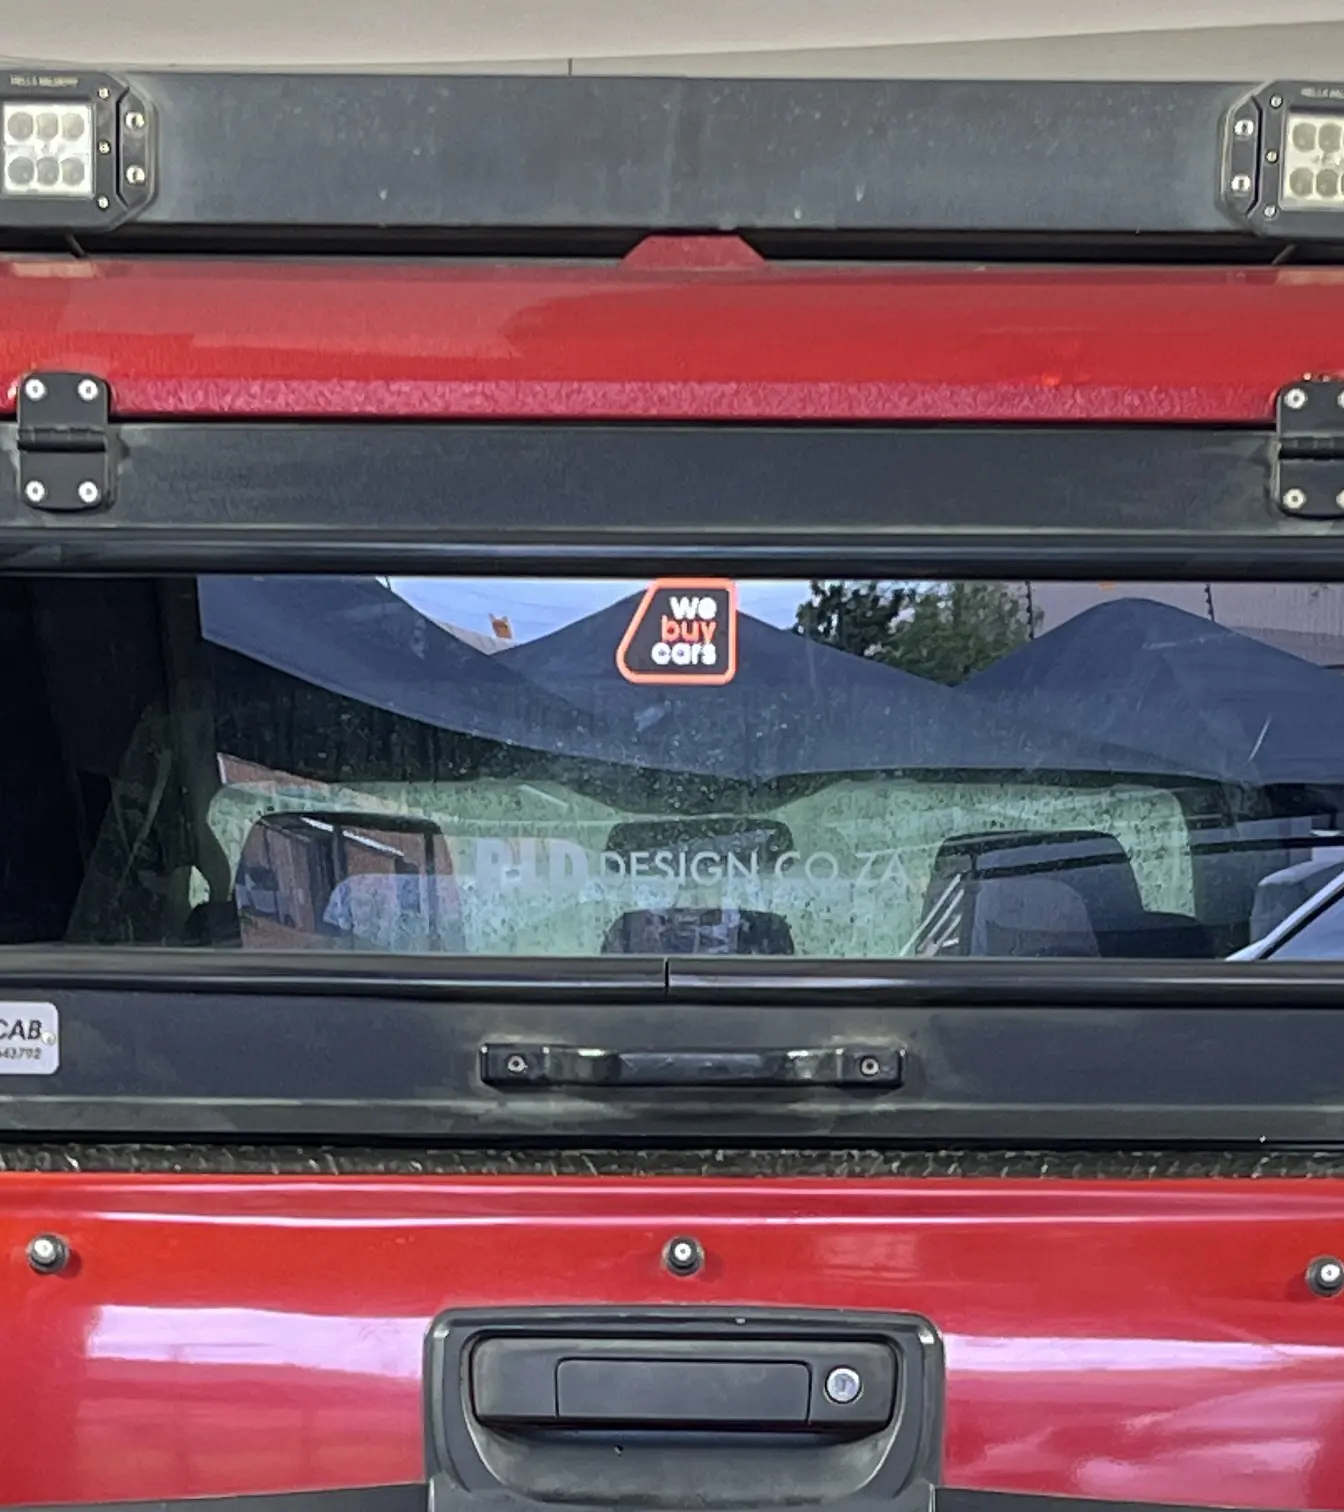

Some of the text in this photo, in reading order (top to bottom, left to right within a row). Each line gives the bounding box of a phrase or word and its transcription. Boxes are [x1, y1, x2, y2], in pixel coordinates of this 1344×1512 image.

[669, 596, 717, 620] we
[661, 614, 716, 645] buy
[651, 642, 716, 665] cars
